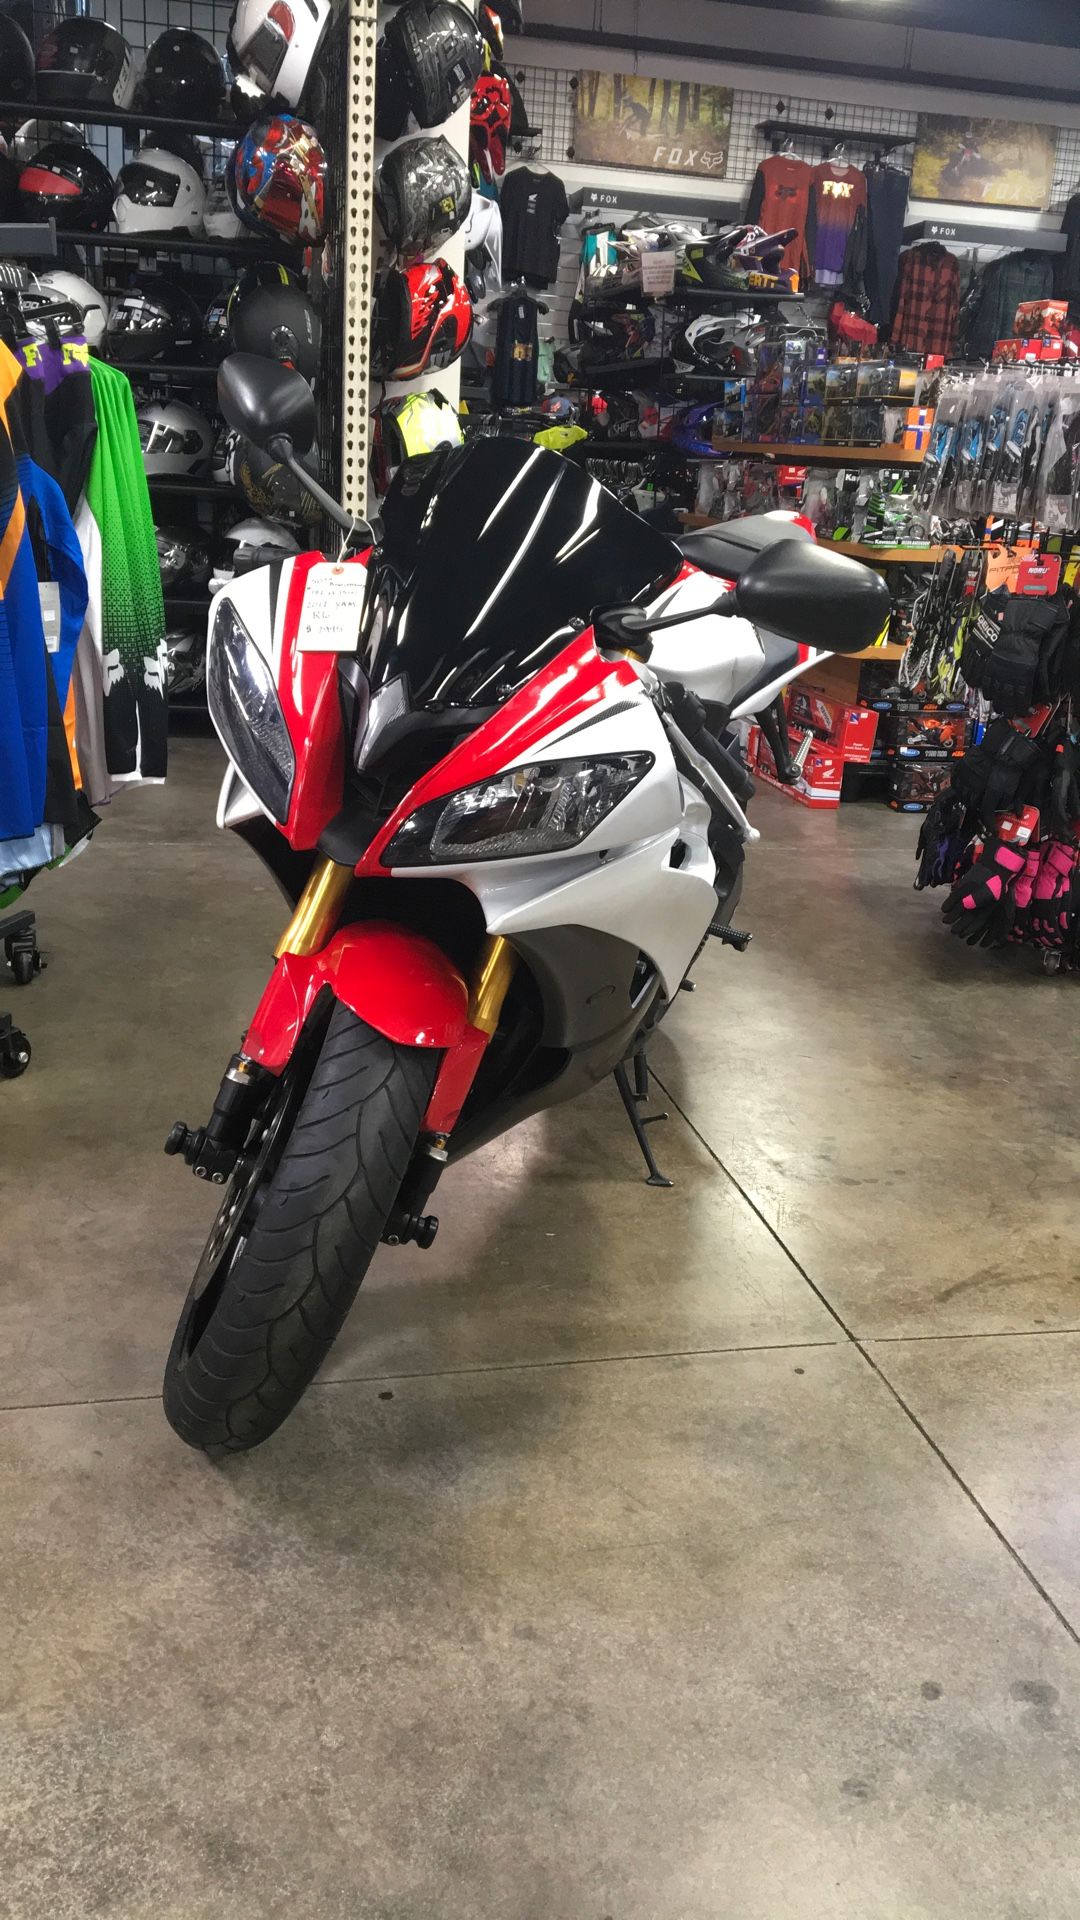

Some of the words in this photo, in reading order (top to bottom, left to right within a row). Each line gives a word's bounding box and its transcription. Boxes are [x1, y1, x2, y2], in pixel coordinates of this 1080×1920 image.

[653, 146, 699, 167] FOX
[600, 194, 618, 204] FOX
[822, 180, 855, 199] FOX
[939, 227, 957, 237] FOX
[977, 614, 999, 643] GEICO
